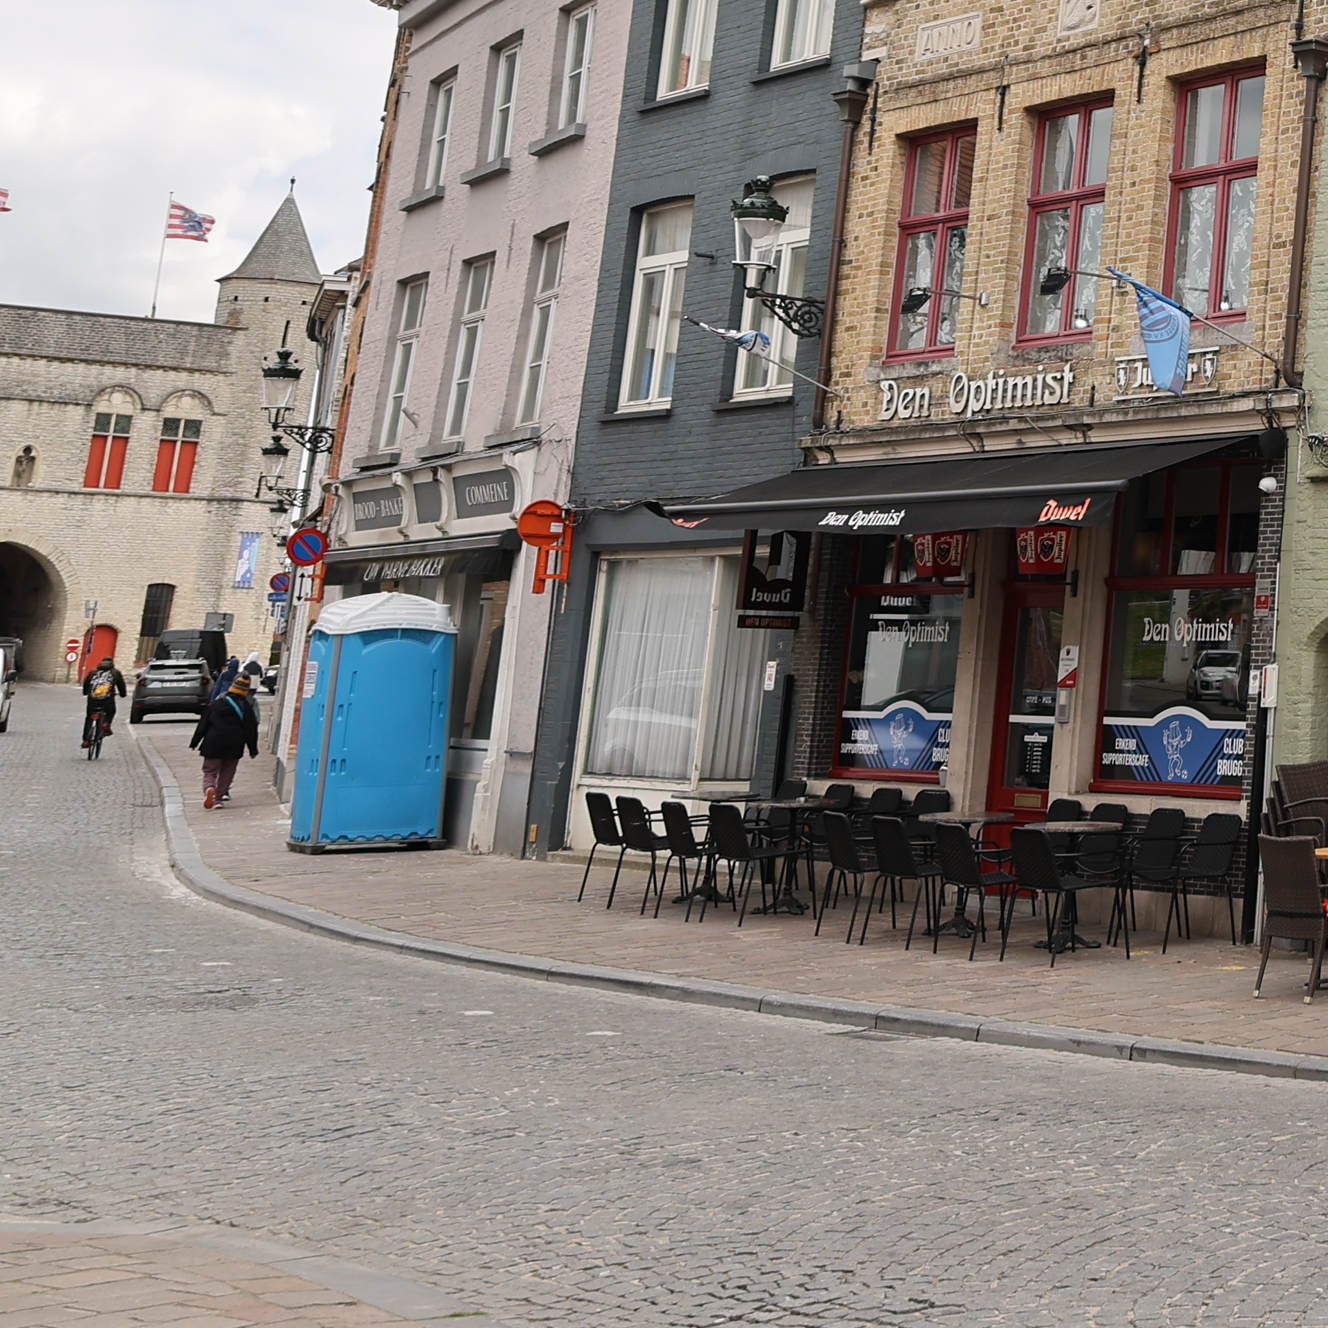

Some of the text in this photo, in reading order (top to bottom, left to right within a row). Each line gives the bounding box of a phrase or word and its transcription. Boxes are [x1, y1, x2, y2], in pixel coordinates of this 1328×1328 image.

[922, 20, 977, 57] ANNO
[878, 379, 931, 421] Den
[949, 361, 1075, 418] Optimist
[818, 509, 906, 530] Den Optimist
[1038, 497, 1092, 523] Duvel
[901, 620, 950, 648] Optimist
[1142, 615, 1234, 647] Den Optimist
[938, 728, 950, 742] CLU
[1115, 737, 1244, 755] ERKEND CLUB
[932, 747, 950, 762] BRUG
[1216, 759, 1244, 777] BRUGG
